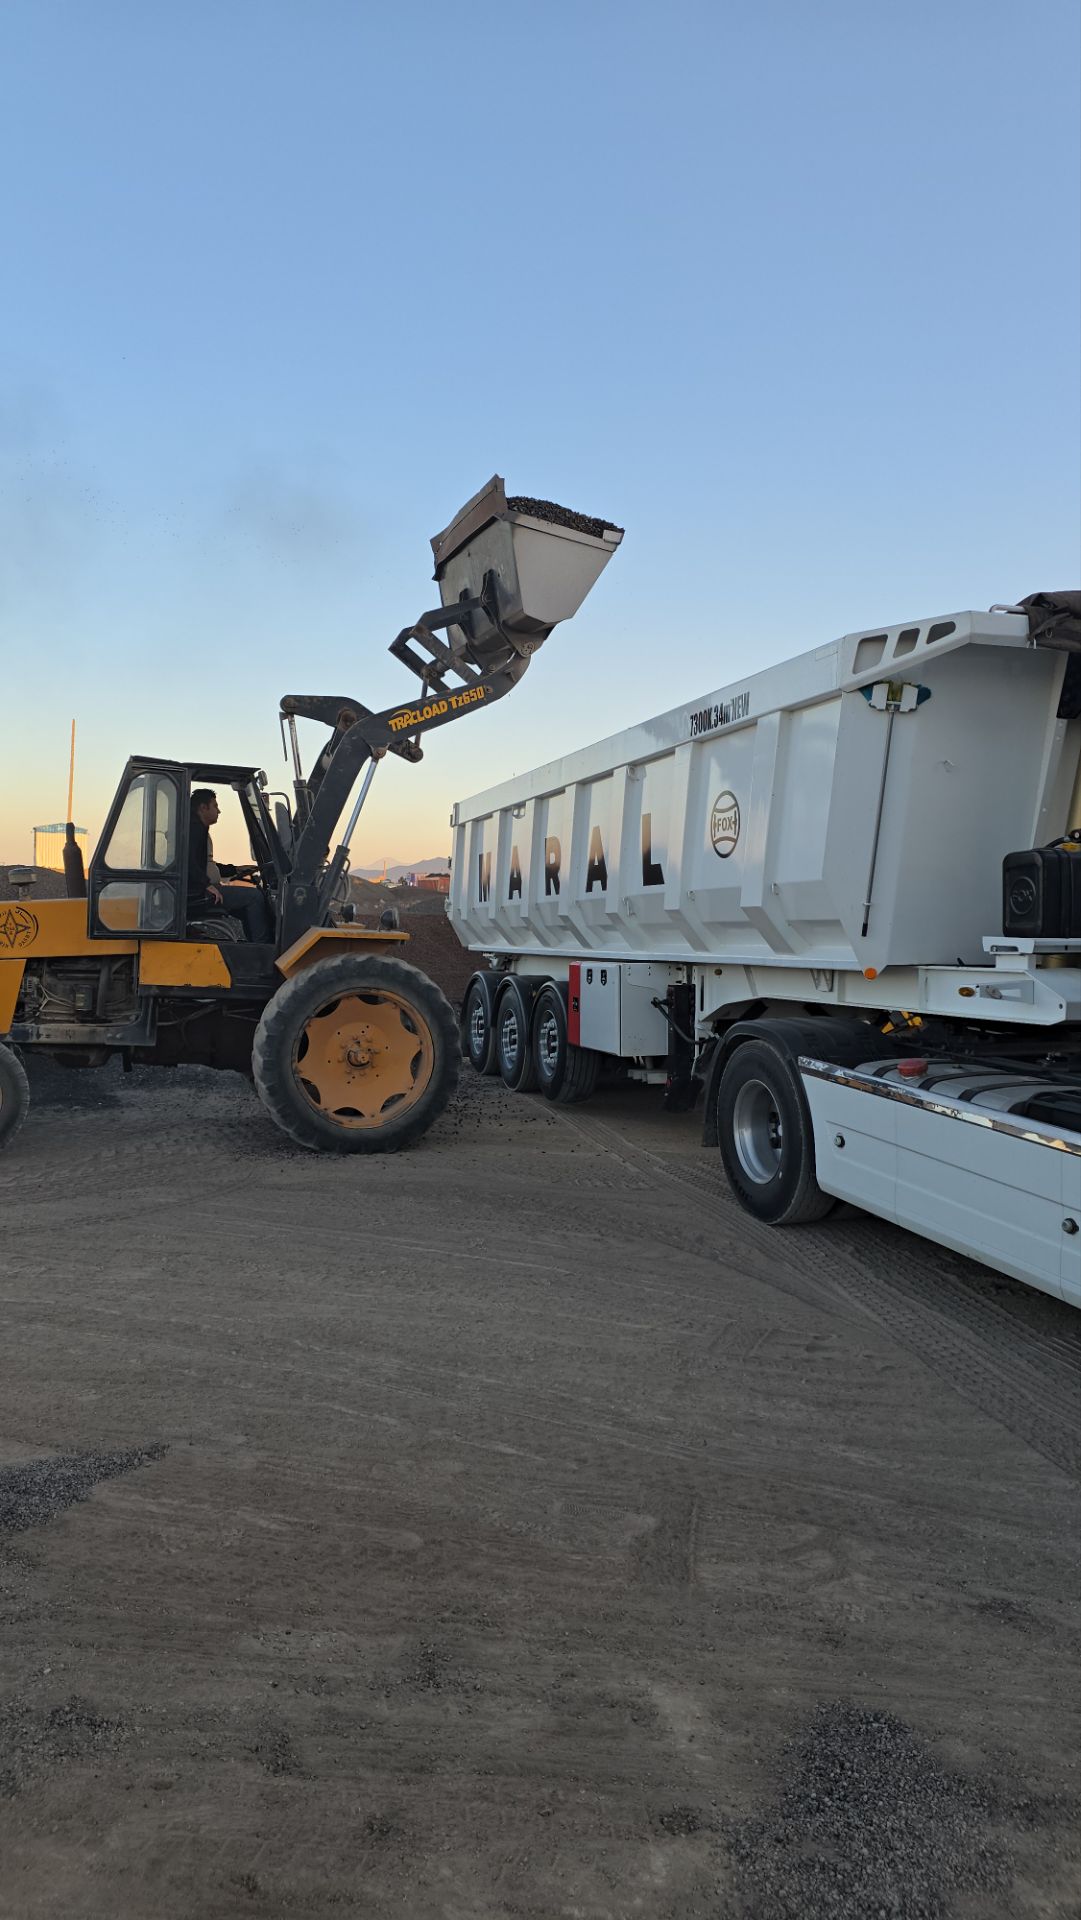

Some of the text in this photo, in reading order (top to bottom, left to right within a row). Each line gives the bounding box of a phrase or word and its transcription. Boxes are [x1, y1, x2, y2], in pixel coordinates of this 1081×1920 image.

[388, 700, 449, 732] TRACLOAD
[717, 816, 733, 832] FOX
[478, 812, 665, 903] MARAL
